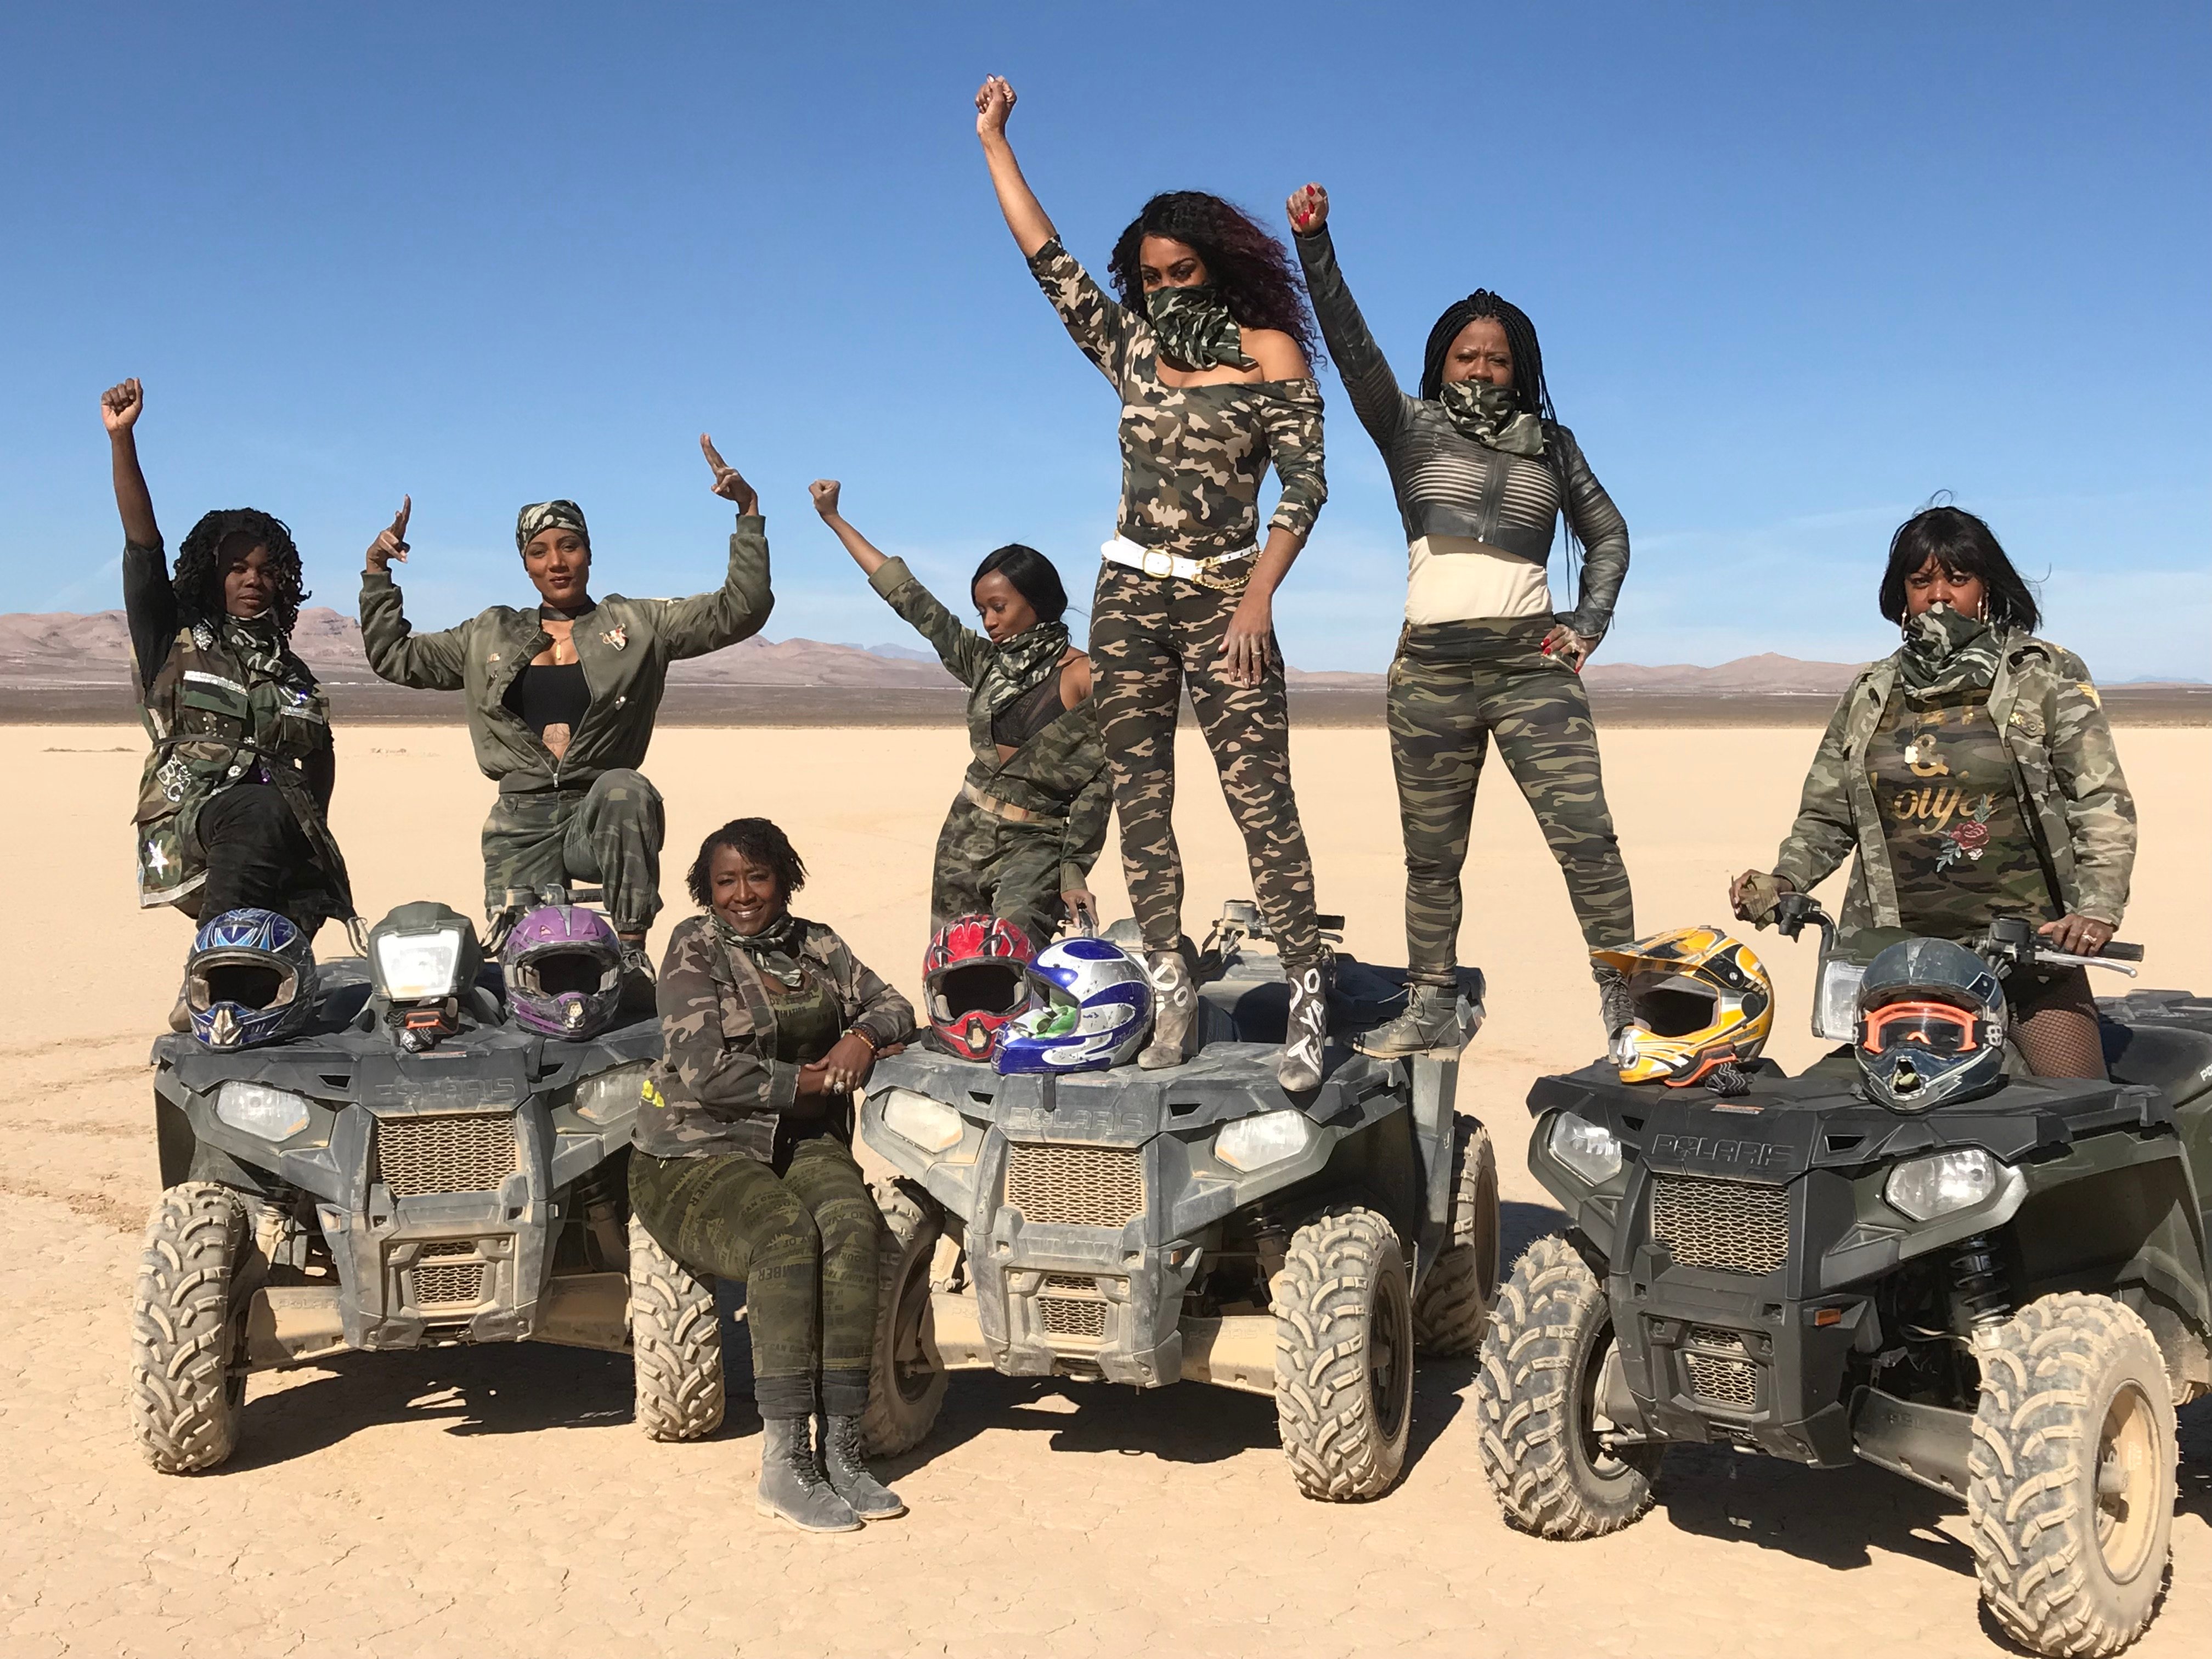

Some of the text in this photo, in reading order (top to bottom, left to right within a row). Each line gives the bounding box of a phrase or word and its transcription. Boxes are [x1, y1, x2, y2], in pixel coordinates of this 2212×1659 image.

[375, 1078, 516, 1098] POLARIS
[1009, 1107, 1144, 1133] POLARIS
[1651, 1134, 1795, 1166] POLARIS
